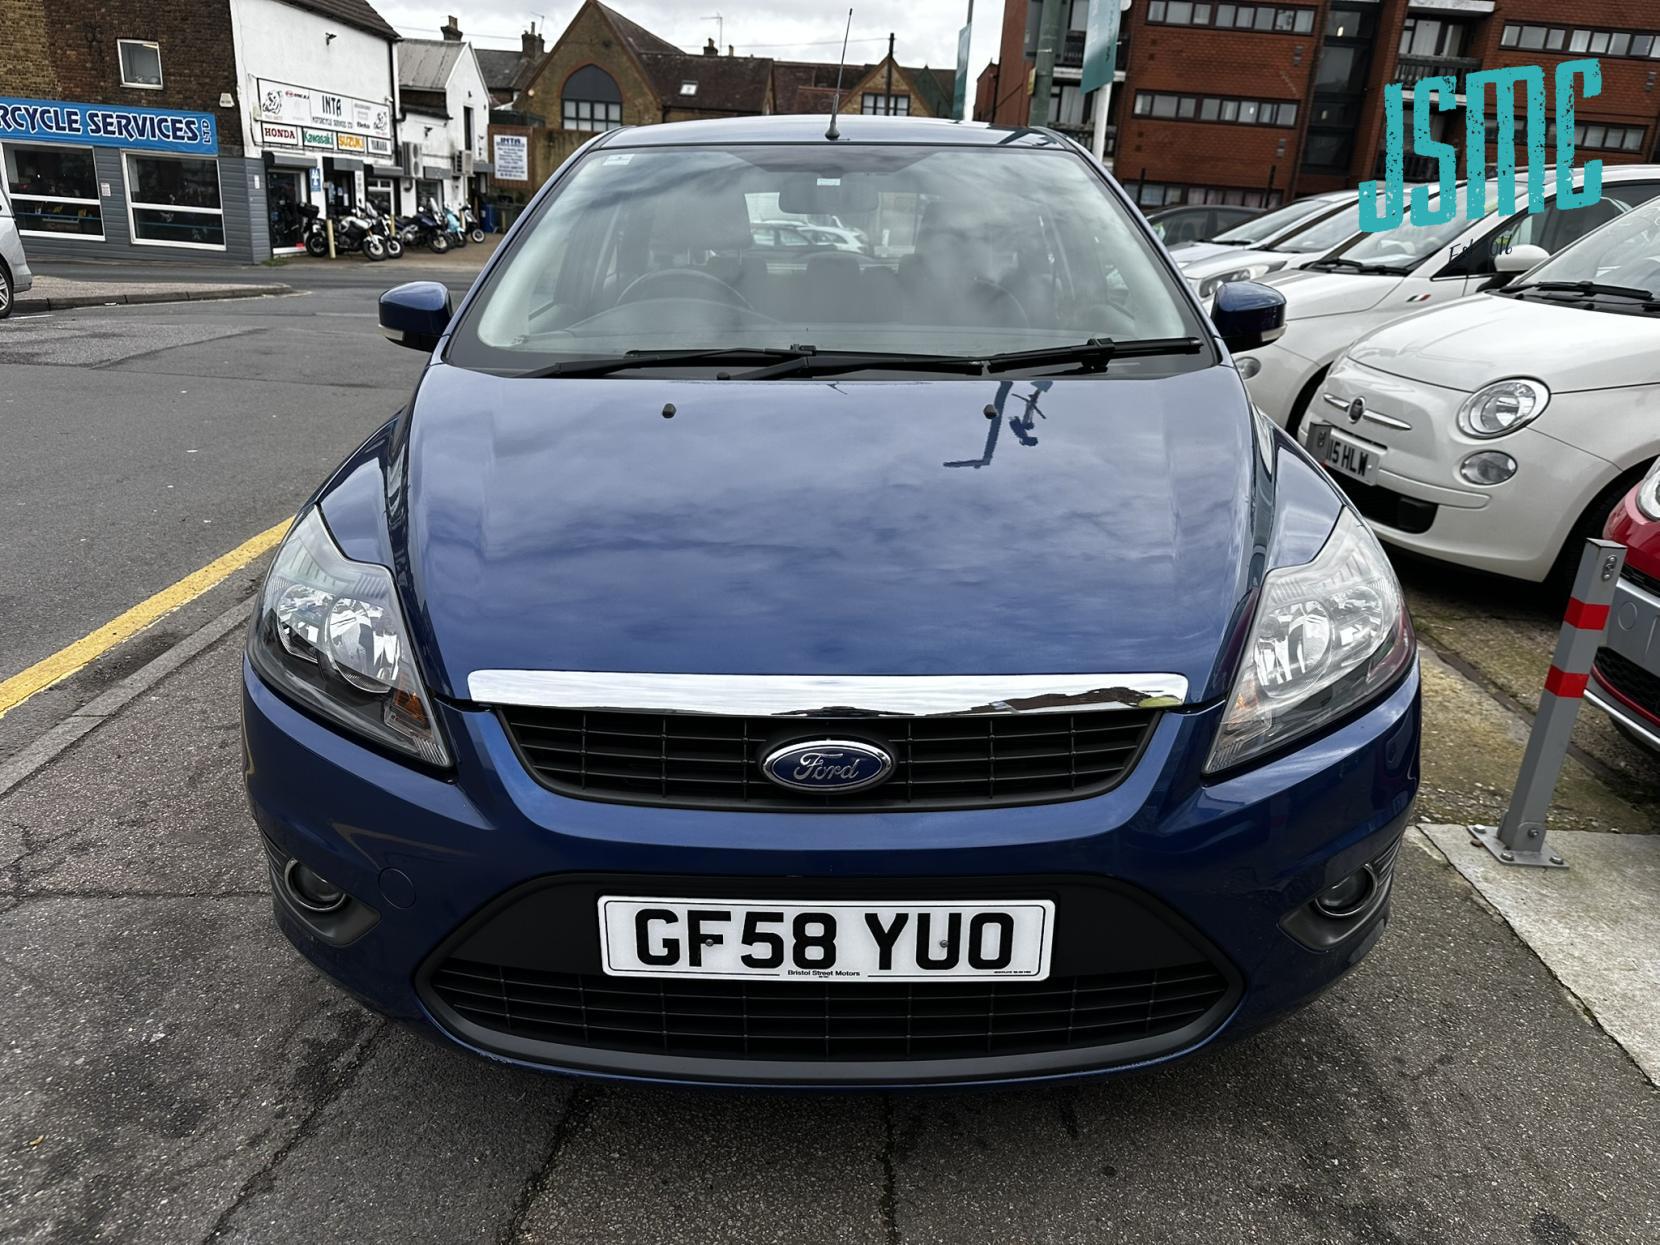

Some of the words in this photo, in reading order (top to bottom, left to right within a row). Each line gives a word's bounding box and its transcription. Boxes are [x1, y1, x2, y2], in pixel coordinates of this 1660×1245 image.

[321, 95, 342, 117] INTA
[87, 110, 200, 143] SERVICES
[201, 118, 211, 145] LTD
[264, 127, 295, 139] HONDA
[793, 752, 861, 780] Ford
[635, 908, 838, 969] GF58
[864, 911, 1015, 971] YUO
